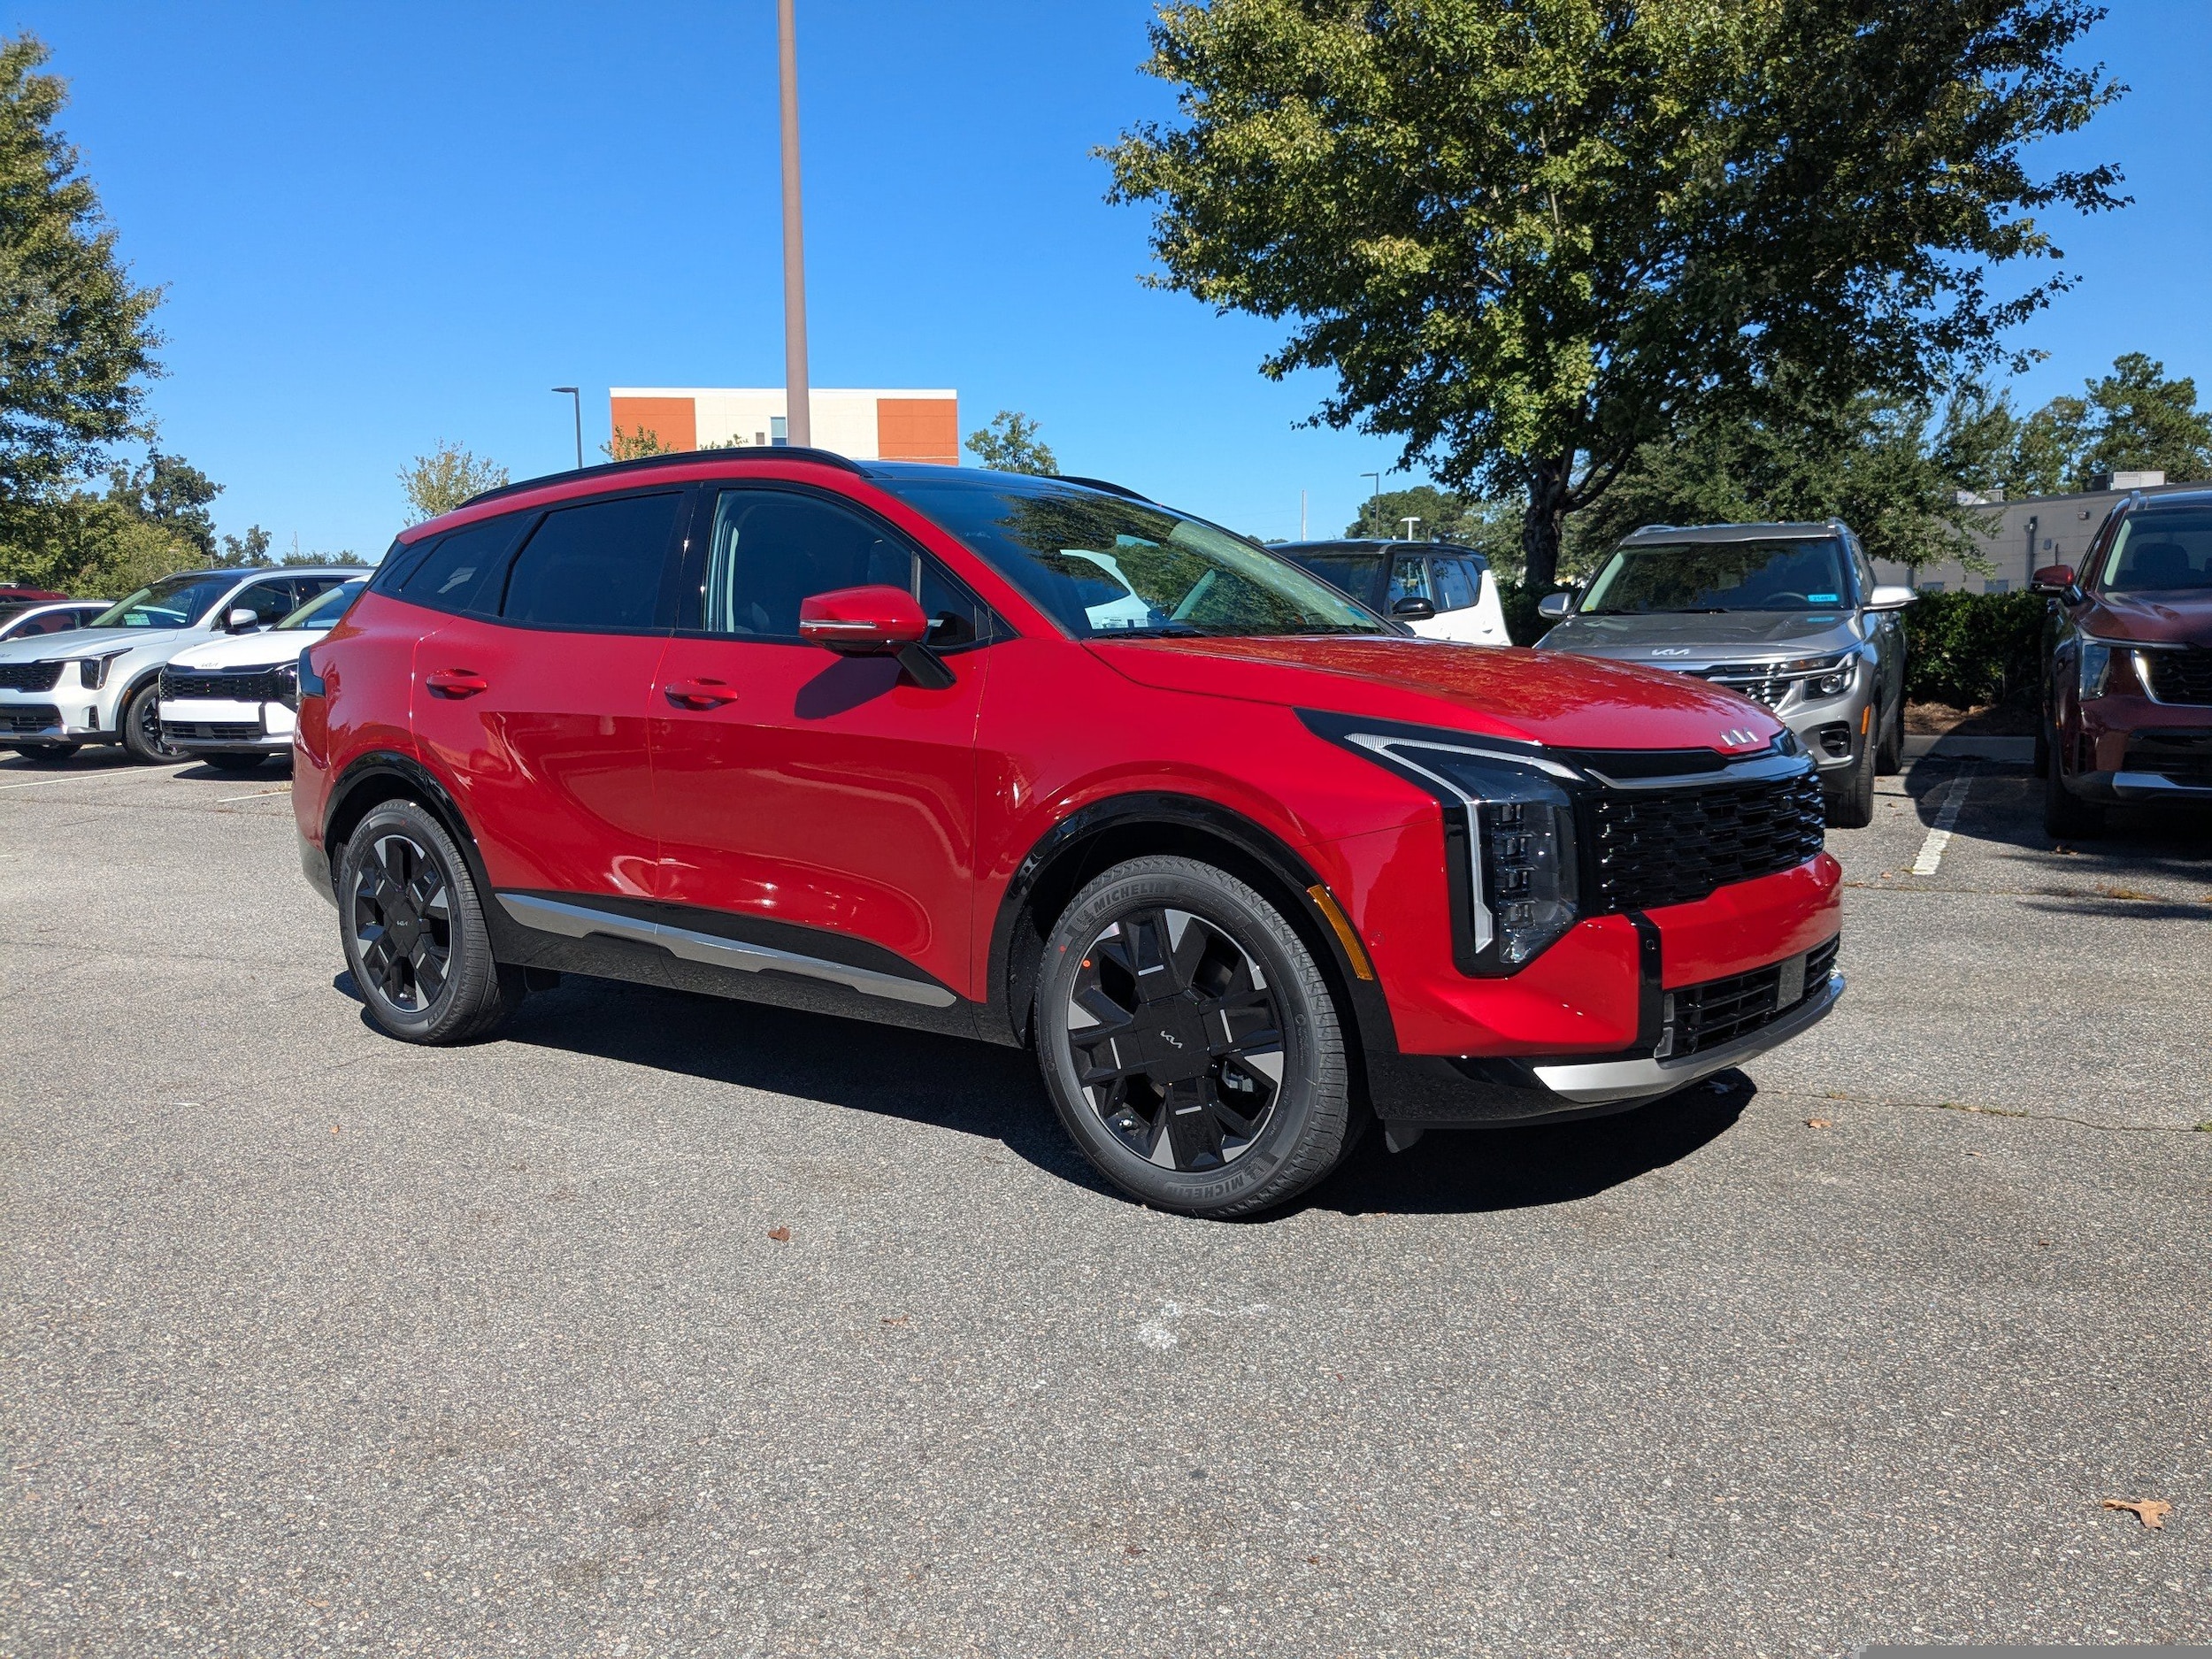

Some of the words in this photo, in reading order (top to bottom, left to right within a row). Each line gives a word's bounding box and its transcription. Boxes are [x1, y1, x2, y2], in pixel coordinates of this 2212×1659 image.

[1094, 883, 1167, 913] MICHELIN
[1160, 1030, 1183, 1049] KIA
[1165, 1174, 1245, 1199] MICHELIN
